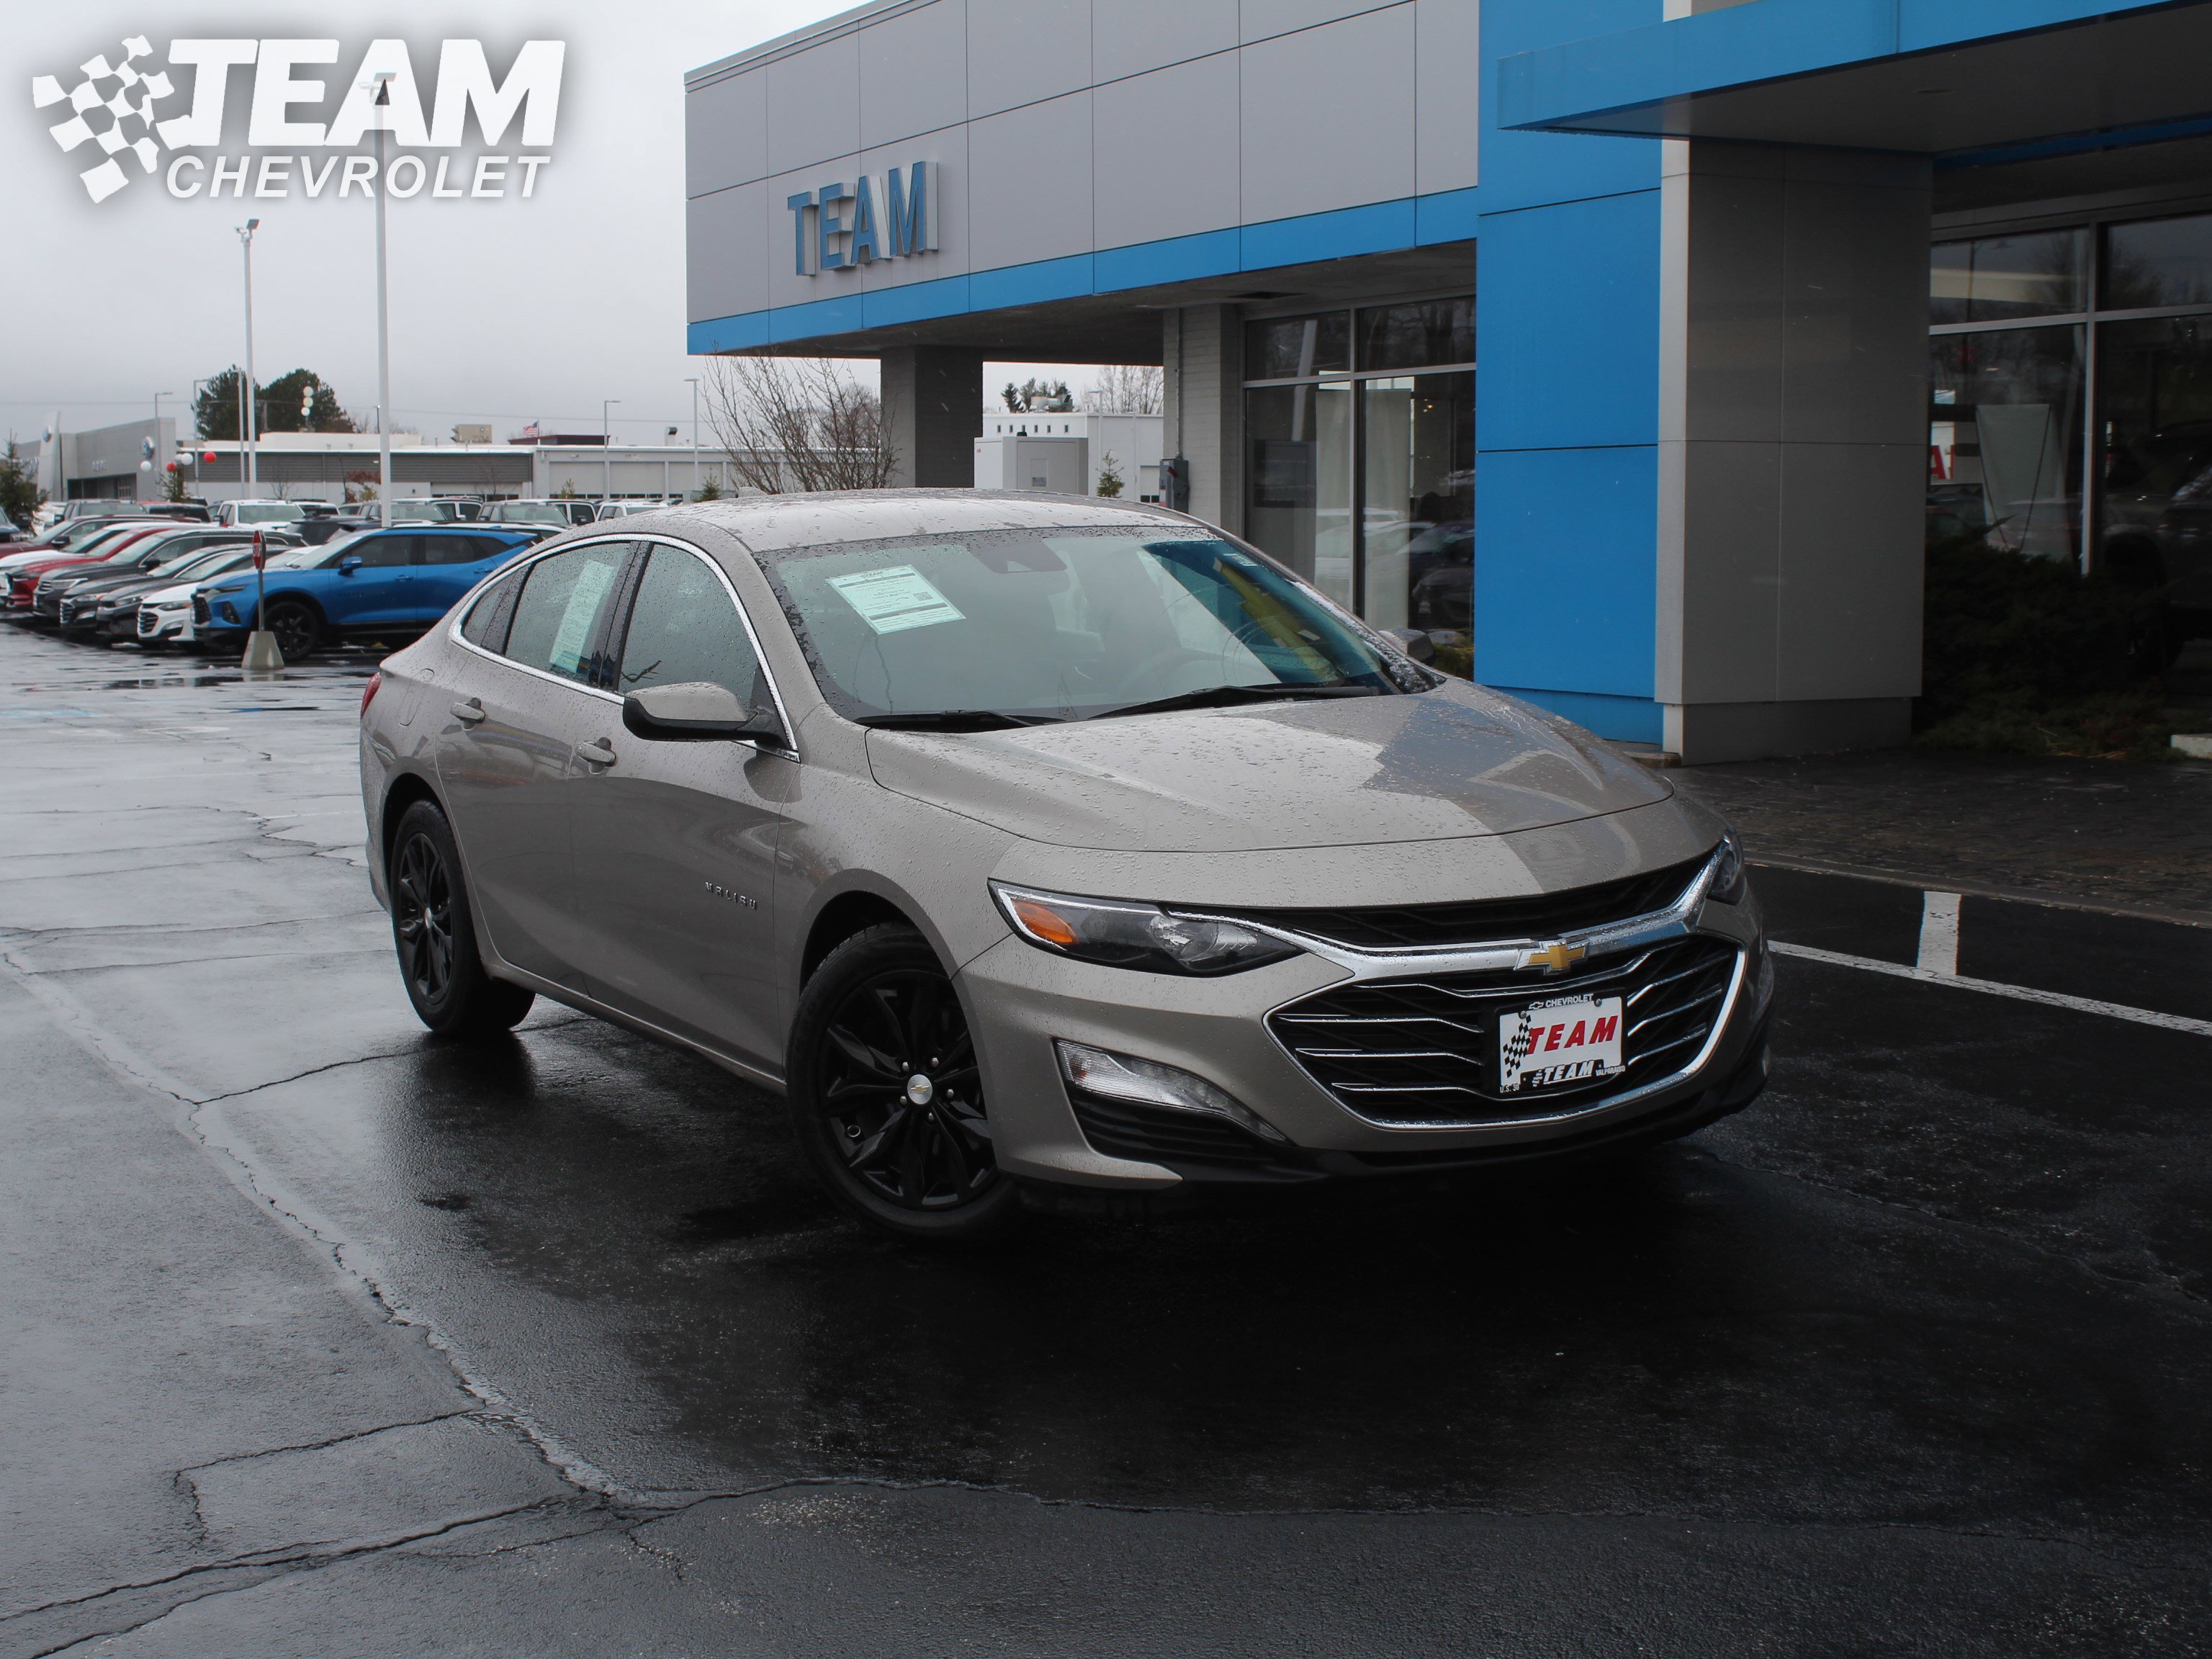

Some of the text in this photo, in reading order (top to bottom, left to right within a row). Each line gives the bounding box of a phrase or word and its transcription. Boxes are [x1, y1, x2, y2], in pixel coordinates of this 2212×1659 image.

[787, 161, 938, 276] TEAM
[1545, 993, 1594, 1008] CHEVROLET
[1526, 1015, 1619, 1055] TEAM
[1543, 1060, 1594, 1083] TEAM
[1595, 1065, 1626, 1076] VALPARAISO
[1500, 1083, 1520, 1093] U.S. 30
